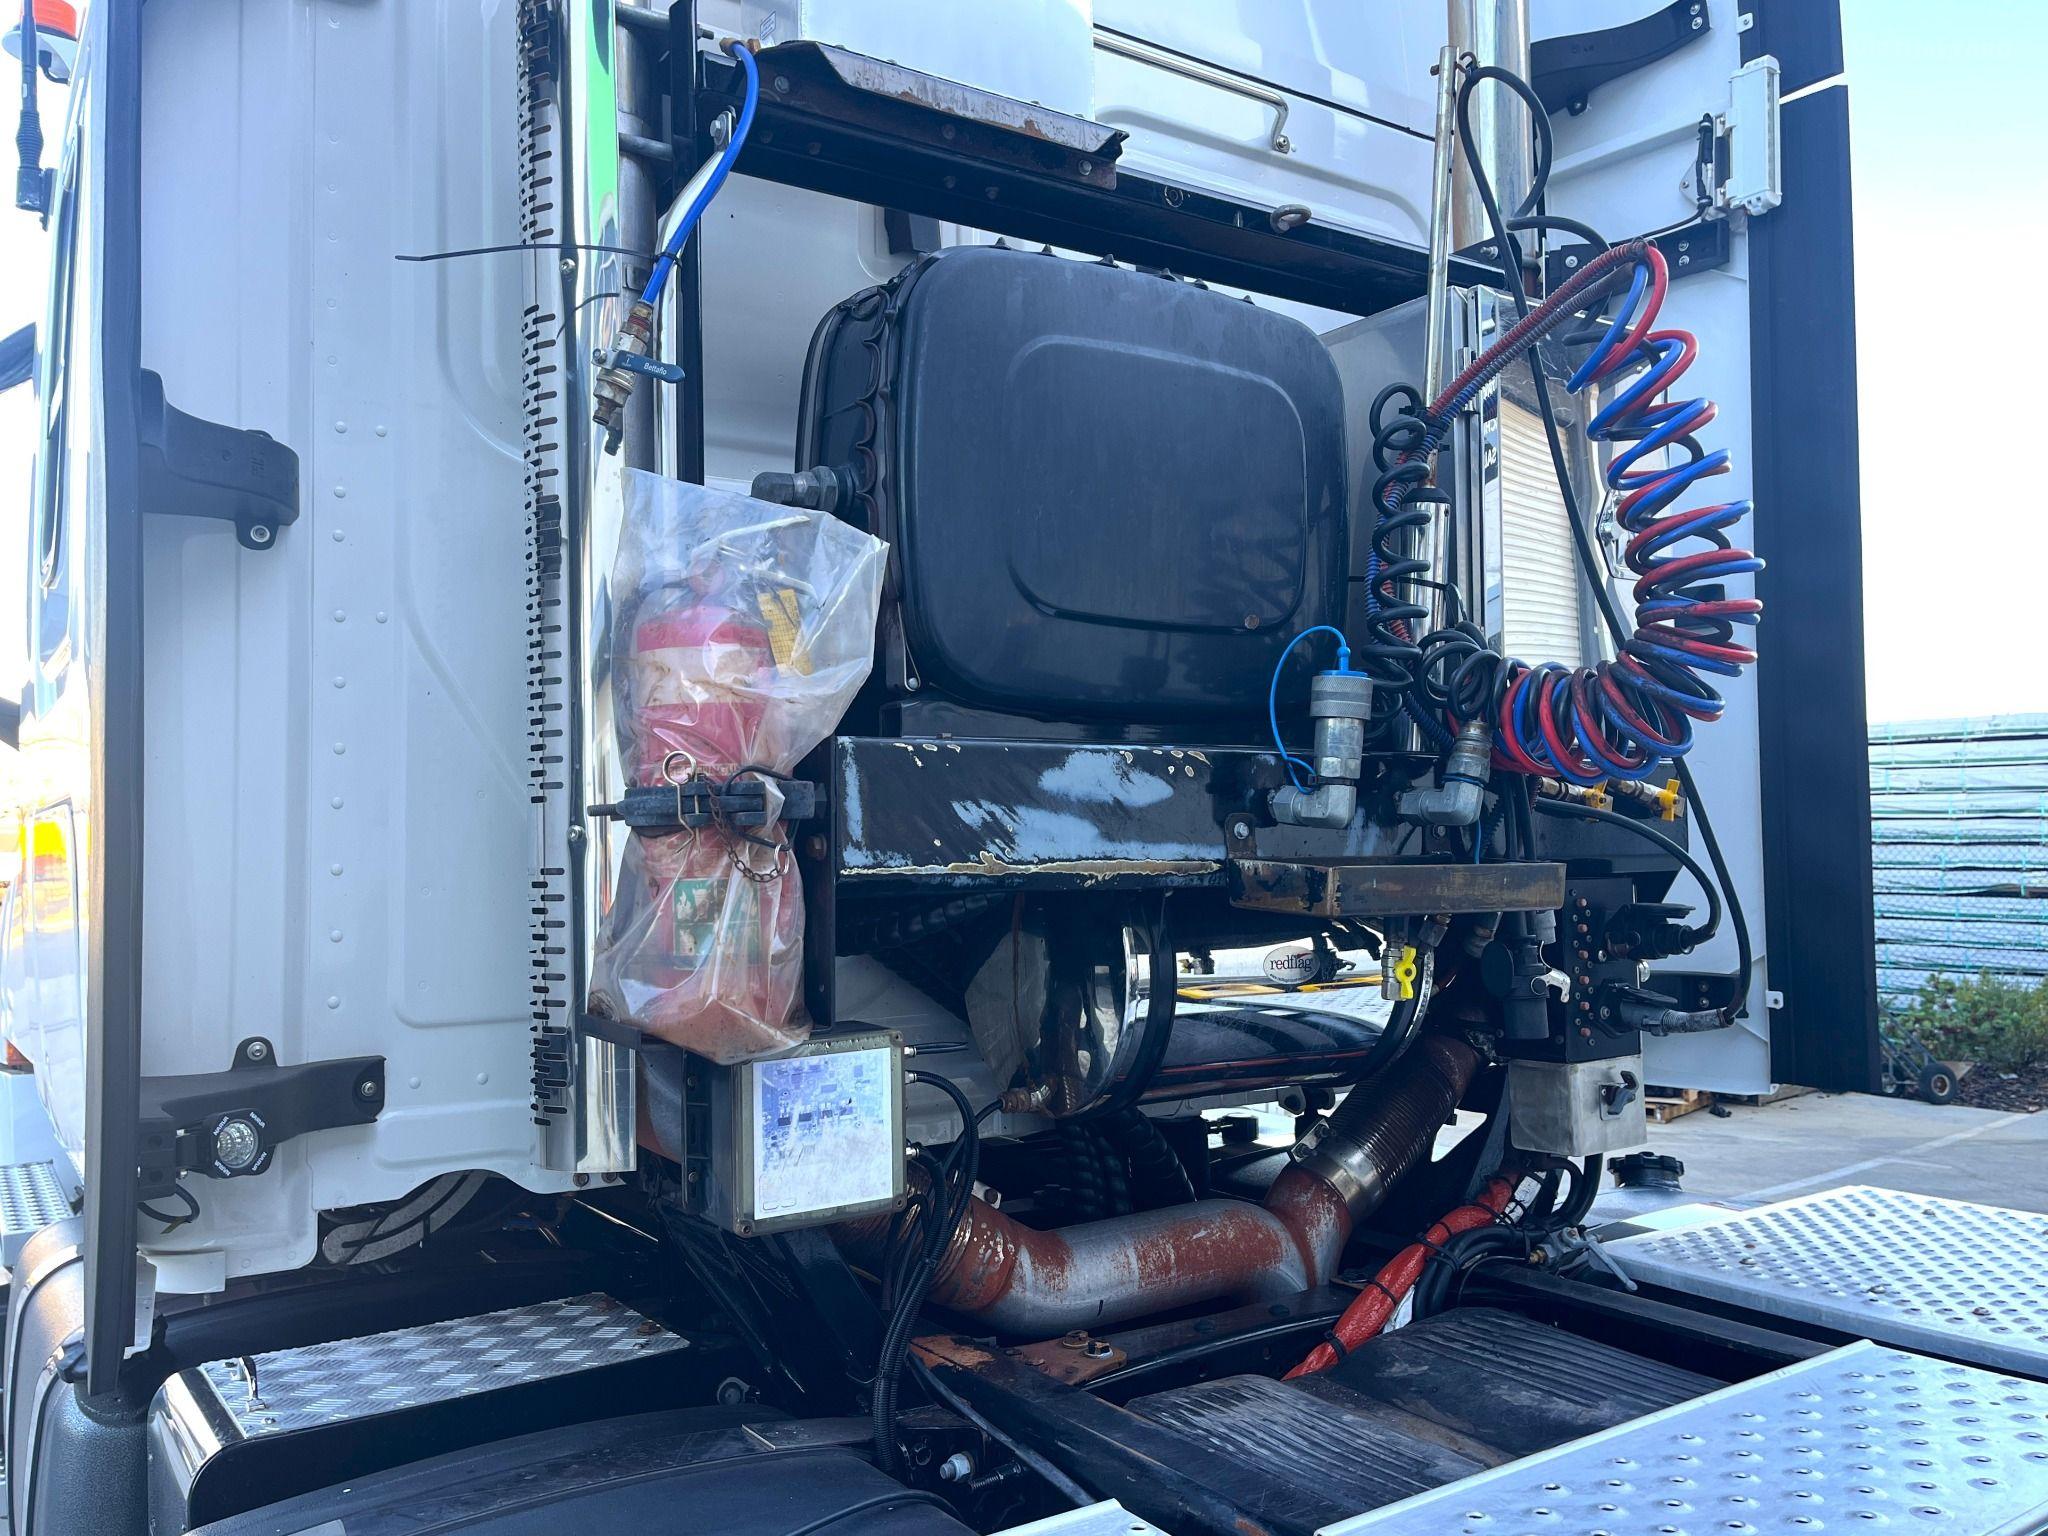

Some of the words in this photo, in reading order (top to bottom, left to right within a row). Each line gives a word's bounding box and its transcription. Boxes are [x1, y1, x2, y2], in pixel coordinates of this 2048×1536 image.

[643, 362, 667, 376] Bettaflo
[1270, 953, 1312, 972] redflag
[213, 1116, 230, 1136] NARVA
